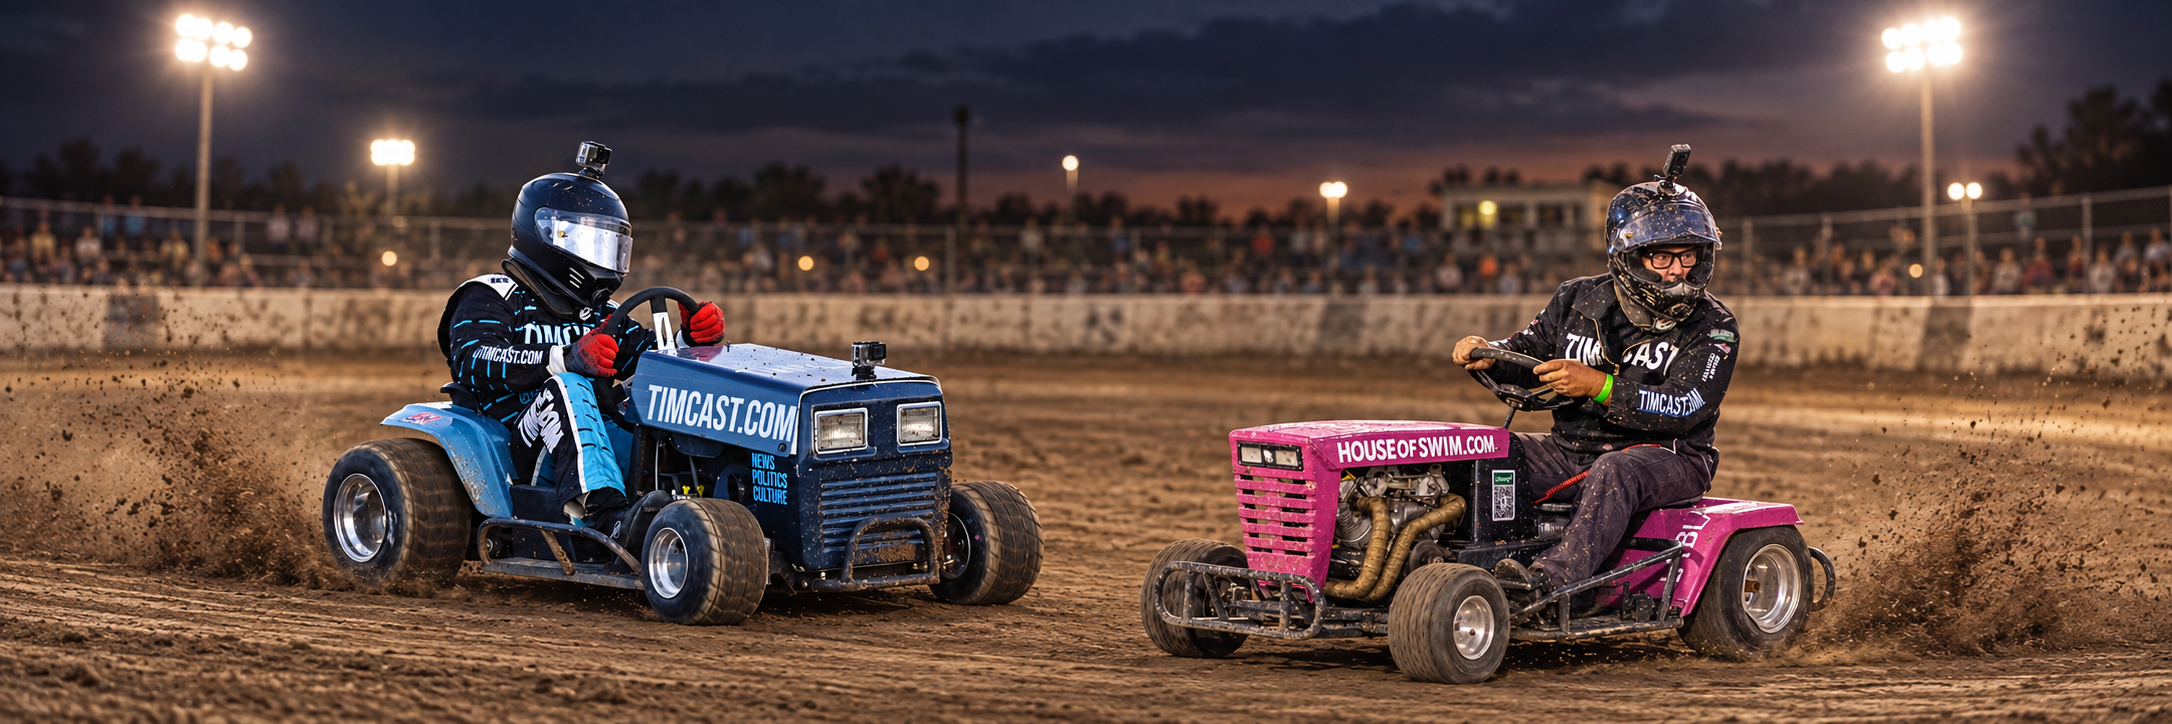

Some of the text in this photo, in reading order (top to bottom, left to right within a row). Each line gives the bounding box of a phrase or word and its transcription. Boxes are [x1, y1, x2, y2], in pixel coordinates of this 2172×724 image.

[1565, 332, 1680, 376] TIMAST
[647, 384, 798, 443] TIMCAST.COM
[751, 453, 775, 470] NEWS
[752, 469, 788, 489] POLITICS
[752, 486, 788, 505] CULTURE
